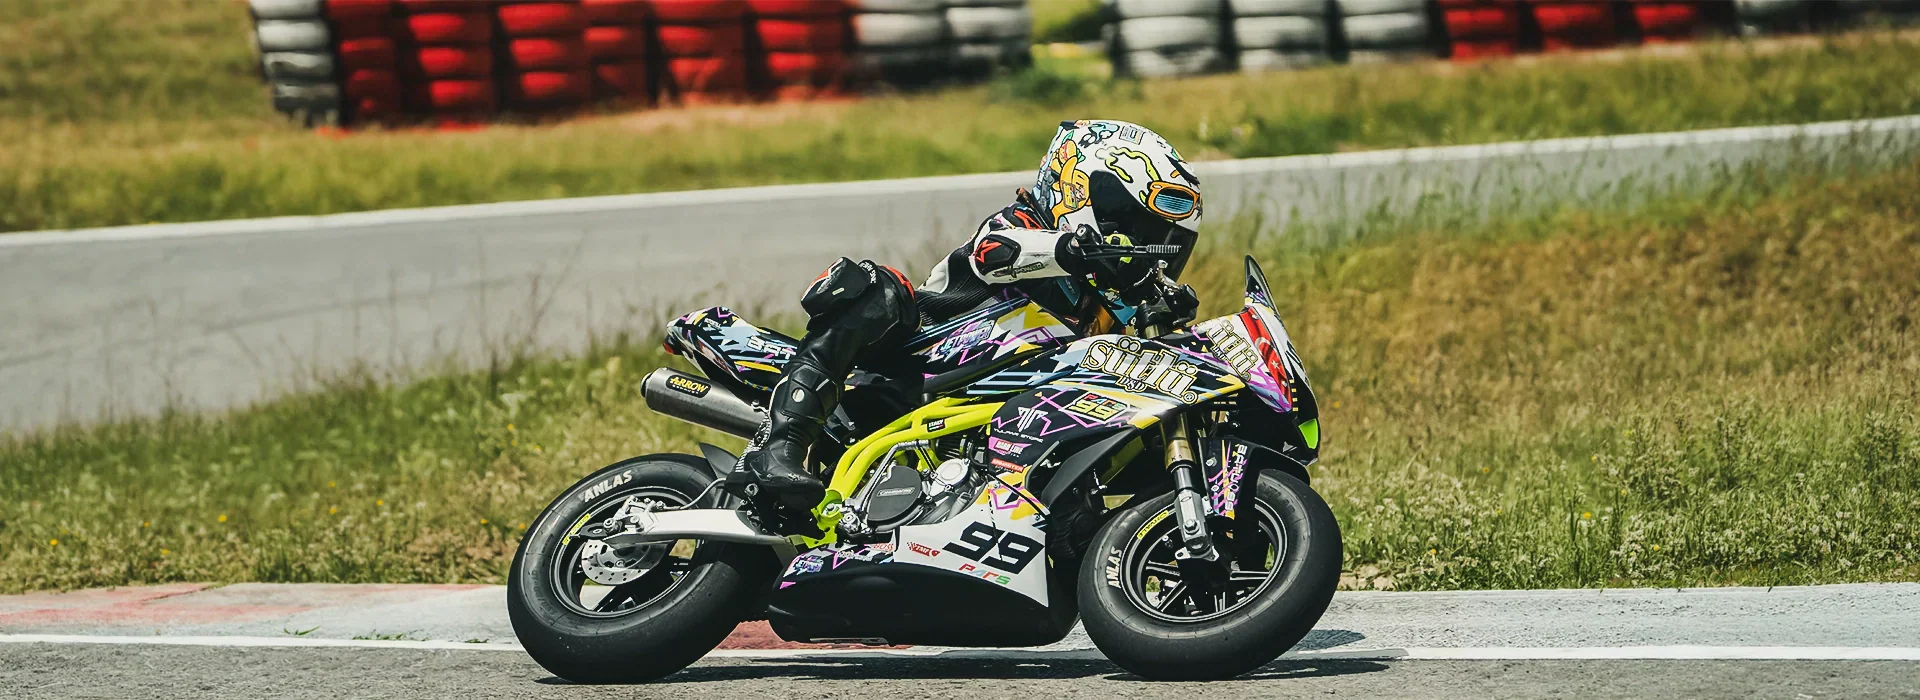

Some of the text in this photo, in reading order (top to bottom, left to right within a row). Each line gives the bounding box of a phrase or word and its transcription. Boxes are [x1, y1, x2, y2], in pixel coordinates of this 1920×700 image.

[670, 376, 709, 393] ARROW
[584, 470, 633, 502] ANLAS
[942, 521, 1046, 575] 99
[1105, 546, 1122, 588] ANLAS
